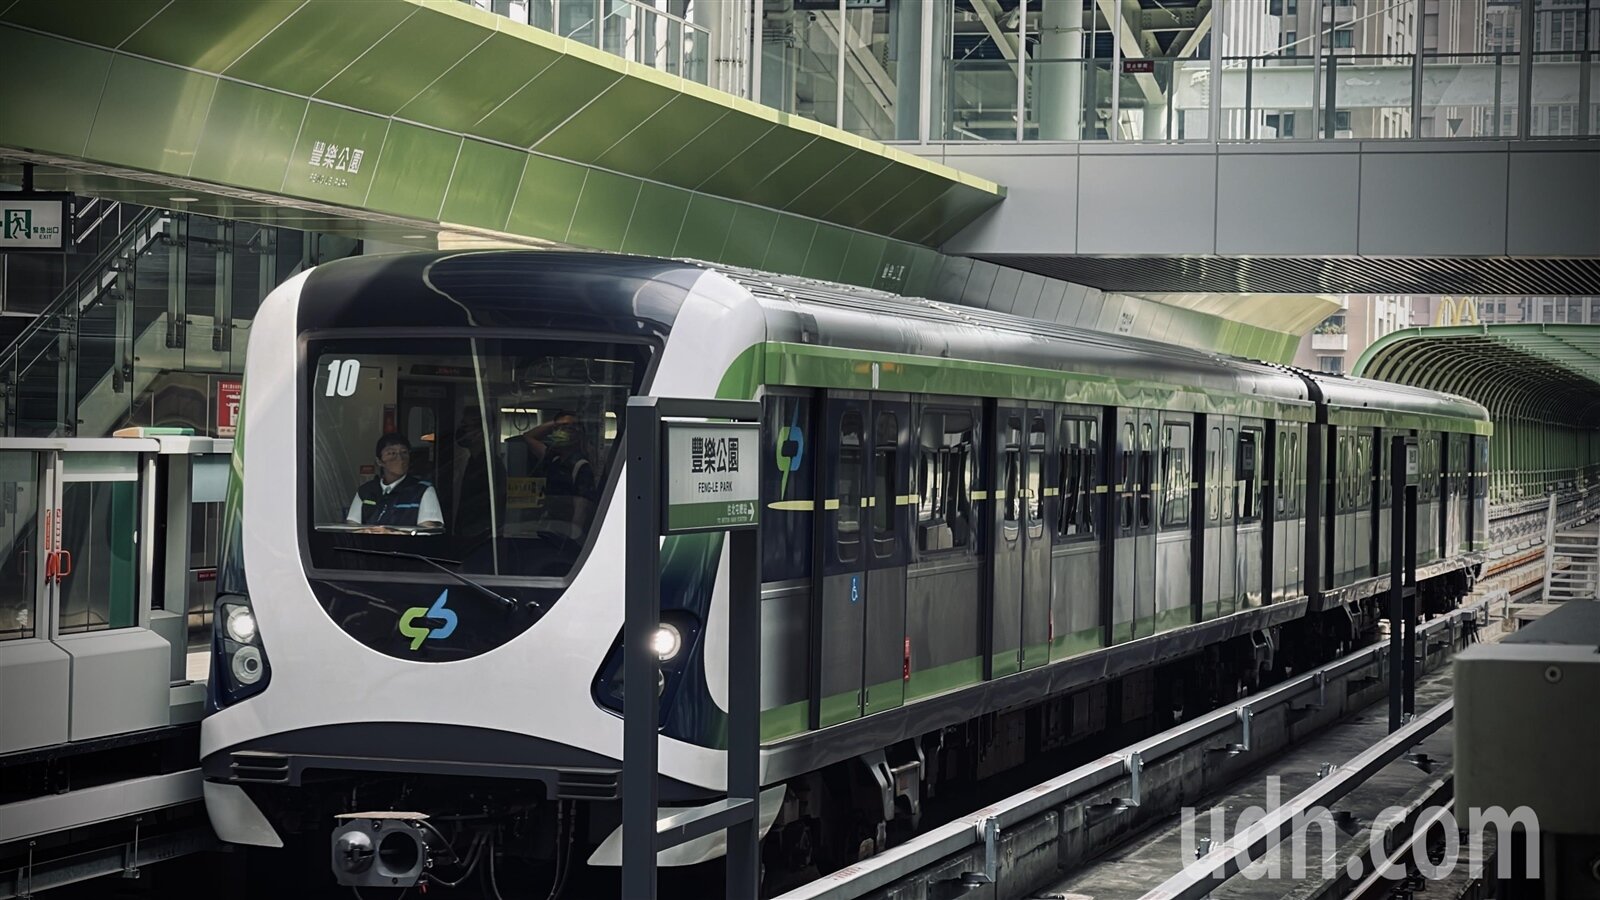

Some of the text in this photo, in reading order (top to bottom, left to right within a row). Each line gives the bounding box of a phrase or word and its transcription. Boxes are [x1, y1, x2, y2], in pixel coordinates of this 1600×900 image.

[308, 140, 364, 174] 豐樂公園
[325, 359, 360, 397] 10
[691, 437, 739, 474] 豐樂公園
[698, 481, 733, 493] FENG-LE PARK
